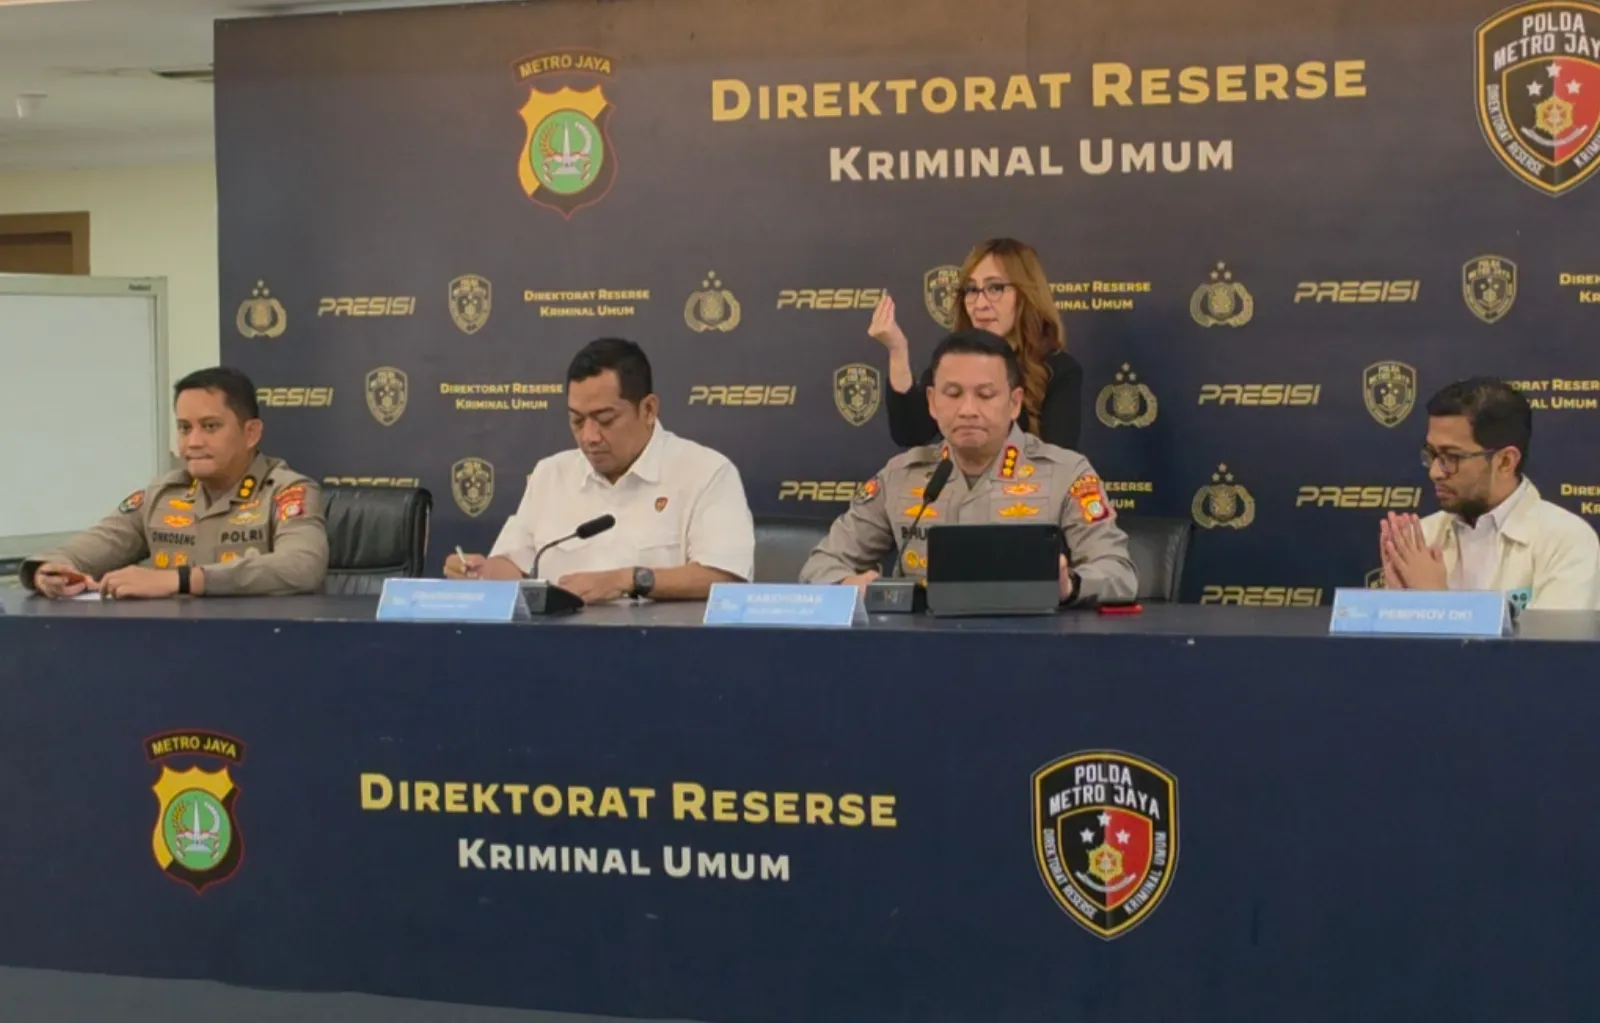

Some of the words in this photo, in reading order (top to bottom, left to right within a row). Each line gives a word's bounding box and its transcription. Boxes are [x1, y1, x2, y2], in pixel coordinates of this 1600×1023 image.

[1522, 11, 1585, 36] POLDA
[1493, 34, 1555, 71] METRO
[1564, 34, 1600, 59] JAY
[519, 54, 572, 78] METRO
[574, 55, 610, 74] JAYA
[711, 73, 1072, 121] DIREKTORAT
[1092, 60, 1367, 107] RESERSE
[829, 145, 1064, 181] KRIMINAL
[1079, 138, 1233, 175] UMUM
[524, 289, 596, 301] DIREKTORAT
[598, 288, 650, 300] RESERSE
[1092, 280, 1151, 292] RESERSE
[1294, 280, 1420, 303] PRESISI
[318, 296, 416, 316] PRESISI
[540, 306, 596, 317] KRIMINAL
[598, 305, 635, 316] UMUM
[1092, 297, 1133, 309] UMUM
[440, 382, 510, 394] DIREKTORAT
[512, 382, 563, 394] RESERSE
[688, 385, 797, 406] PRESISI
[1198, 383, 1321, 406] PRESISI
[1552, 378, 1600, 391] RESER
[256, 387, 334, 407] RESISI
[456, 398, 510, 410] KRIMINAL
[511, 398, 548, 410] UMUM
[1551, 397, 1597, 409] UMUM
[1102, 481, 1152, 491] ESERSE
[1295, 486, 1422, 508] PRESISI
[221, 529, 264, 543] POLRI
[1200, 585, 1323, 608] PRESISI
[152, 735, 200, 756] METRO
[203, 737, 237, 758] JAYA
[1074, 763, 1133, 787] POLDA
[360, 773, 656, 819] DIREKTORAT
[672, 782, 897, 827] RESERSE
[1049, 785, 1105, 817] METRO
[1114, 785, 1160, 820] JAYA
[458, 838, 651, 876] KRIMINAL
[663, 845, 790, 881] UMUM
